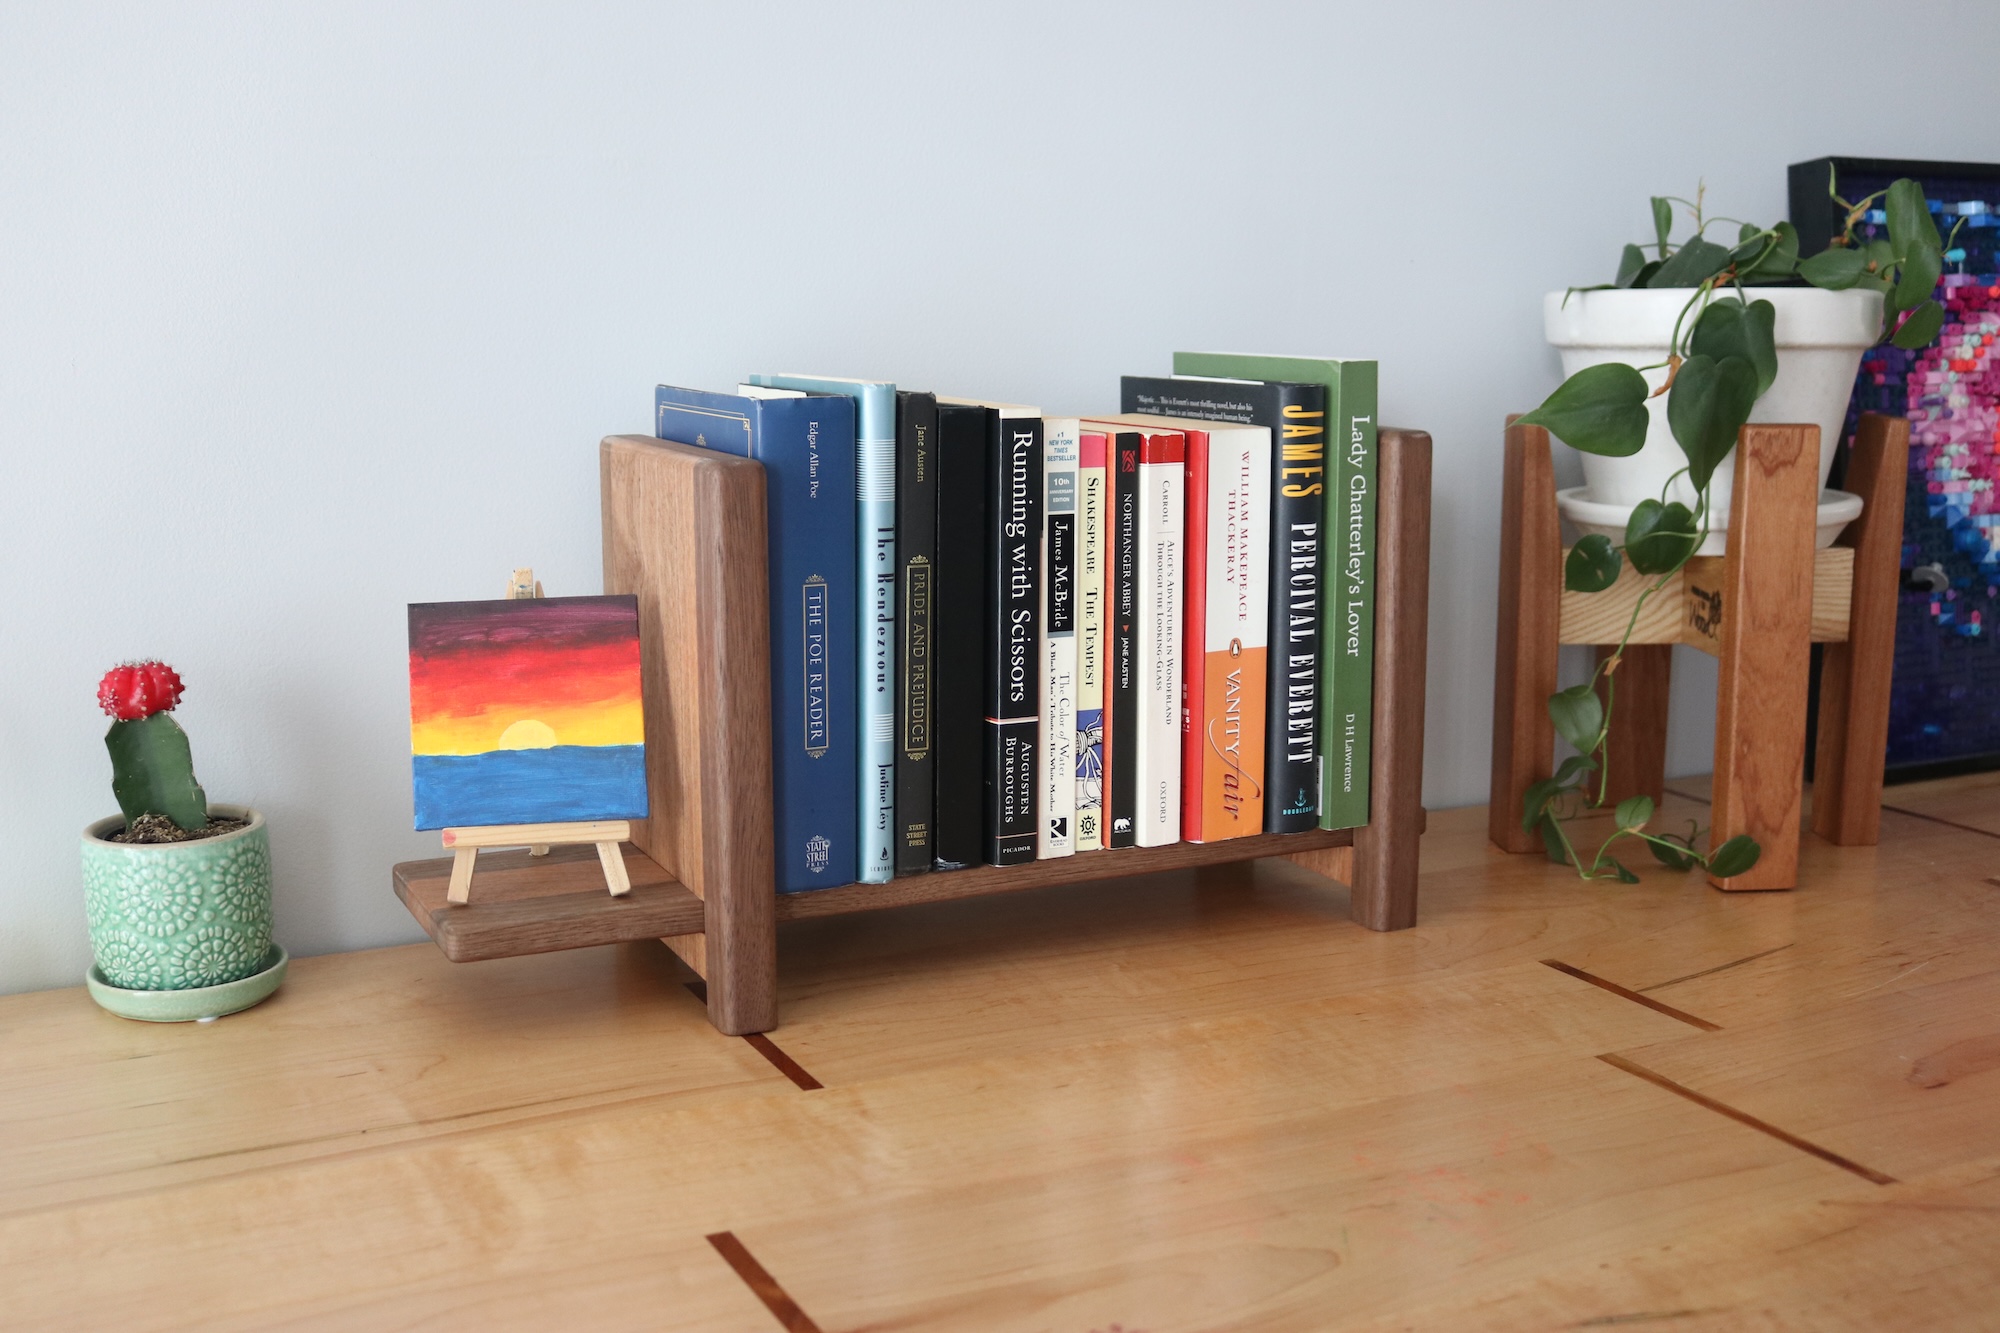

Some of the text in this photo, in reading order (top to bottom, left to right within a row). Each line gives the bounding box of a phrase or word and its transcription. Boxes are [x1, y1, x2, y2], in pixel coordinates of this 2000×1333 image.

[807, 421, 819, 498] Edgar Allan Poe
[915, 425, 926, 482] Jane Austen
[1282, 405, 1324, 498] JAMES
[1348, 415, 1370, 469] Lady
[1053, 478, 1070, 486] 10th
[1162, 480, 1170, 525] CARROLL
[1005, 430, 1033, 702] Running with Scissors
[1122, 493, 1132, 577] NORTHANGER
[1226, 489, 1236, 583] THACKERAY
[1238, 450, 1249, 621] WILLIAM MAKEPEACE
[877, 524, 895, 692] The Rendezvous
[1055, 521, 1068, 628] James McBride
[1085, 478, 1099, 688] SHAKESPEARE THE TEMPEST
[1122, 581, 1131, 617] ABBEY
[1166, 580, 1174, 641] ADVENTURES
[809, 592, 823, 741] THE POE READER
[911, 573, 925, 743] PRIDE AND PREJUDICE
[1121, 637, 1129, 656] JANE
[1156, 611, 1164, 691] LOOKING-GLASS
[1166, 645, 1173, 655] IN
[1288, 522, 1317, 764] PERCIVAL EVERETT
[1347, 600, 1364, 657] Lover
[1056, 672, 1070, 777] The Color of Water
[1166, 658, 1174, 725] WONDERLAND
[1225, 668, 1241, 758] VANITY
[878, 763, 893, 803] Justine
[1005, 737, 1017, 823] BURROUGHS
[1020, 742, 1032, 815] AUGUSTEN
[1344, 713, 1355, 793] D H Lawrence
[806, 841, 826, 852] STATE
[906, 831, 927, 839] STREET
[909, 839, 926, 847] PRESS
[1003, 846, 1031, 854] PICADOR
